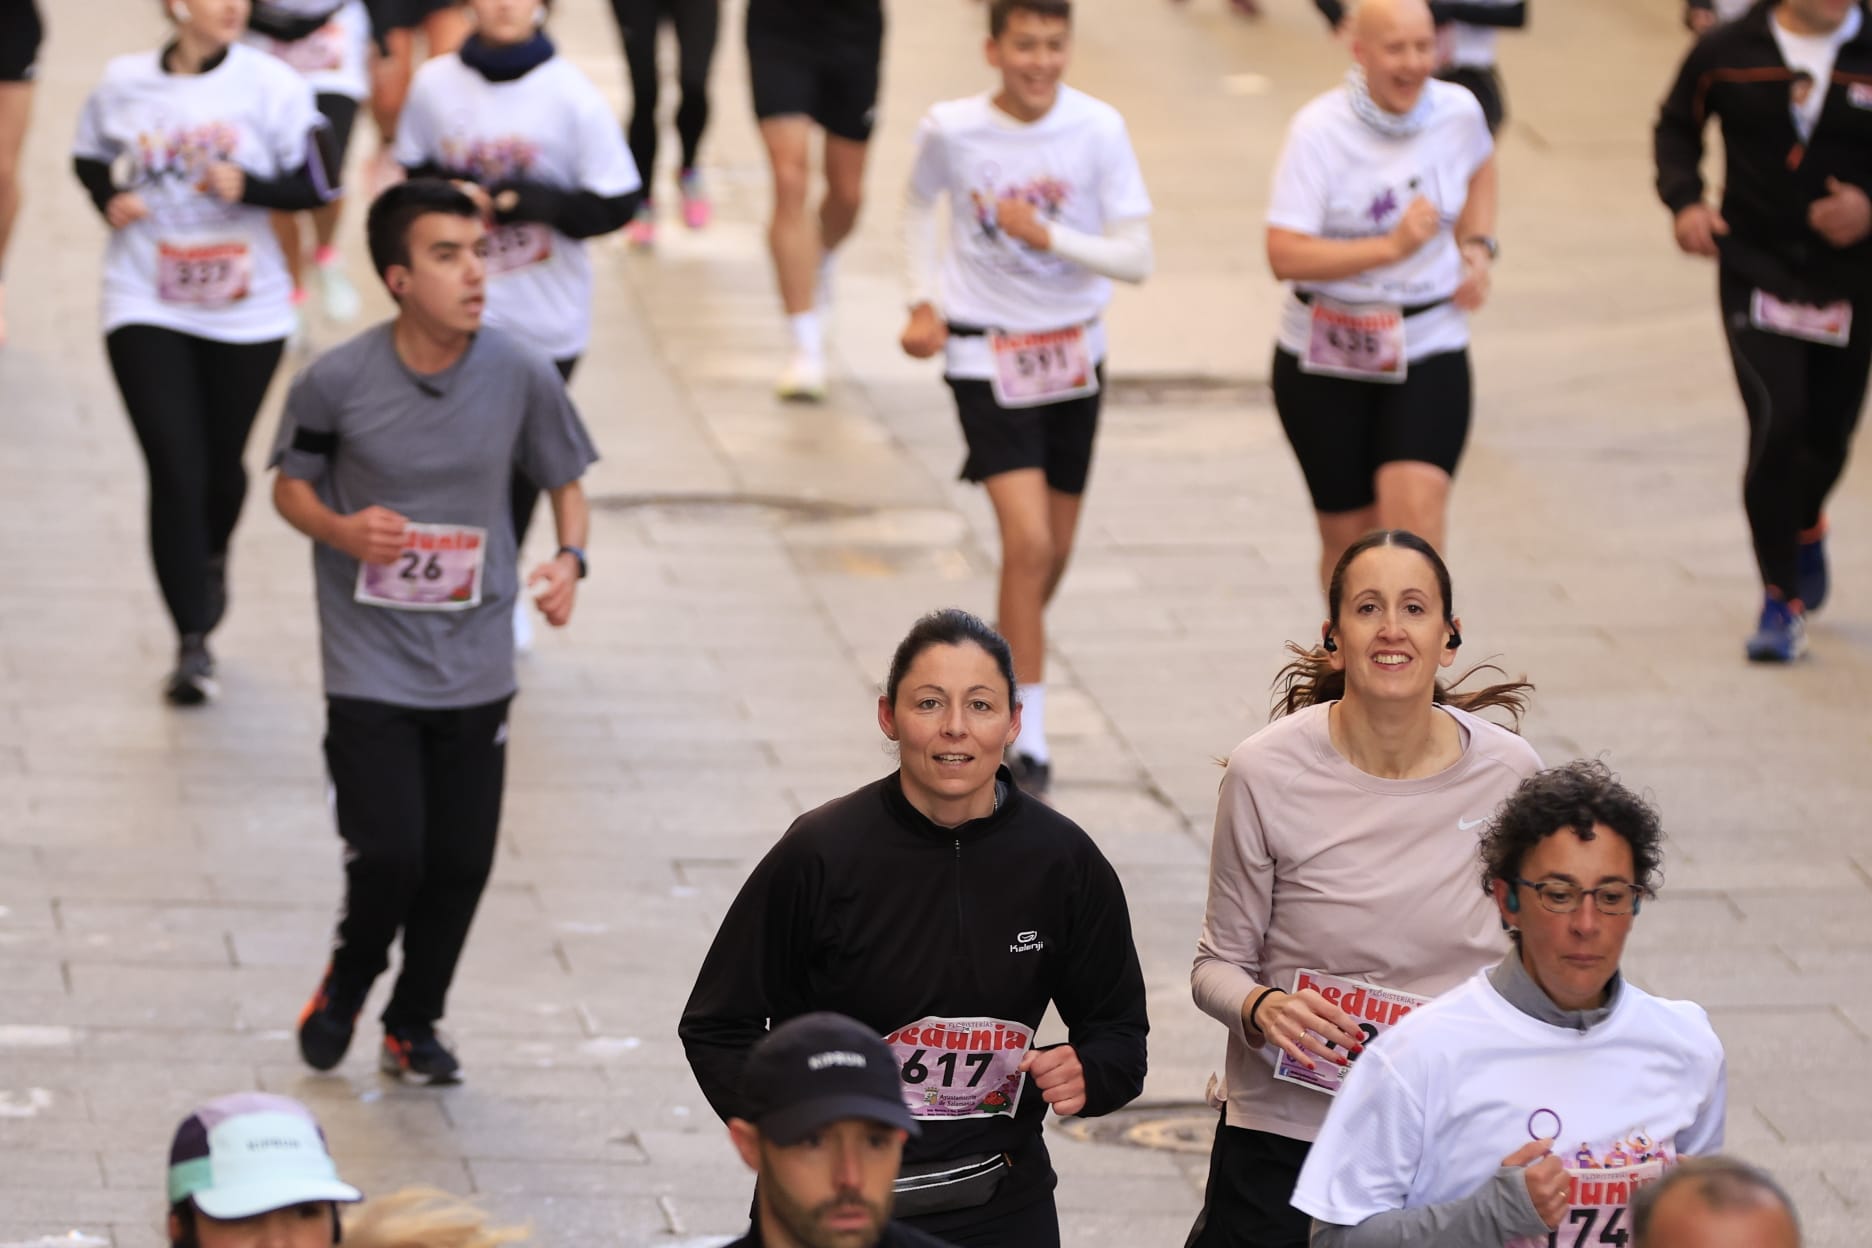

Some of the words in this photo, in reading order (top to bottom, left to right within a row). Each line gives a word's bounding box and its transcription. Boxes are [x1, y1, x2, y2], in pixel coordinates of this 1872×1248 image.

[400, 552, 443, 580] 26
[1010, 941, 1043, 952] Kalenji
[901, 1049, 994, 1087] 617
